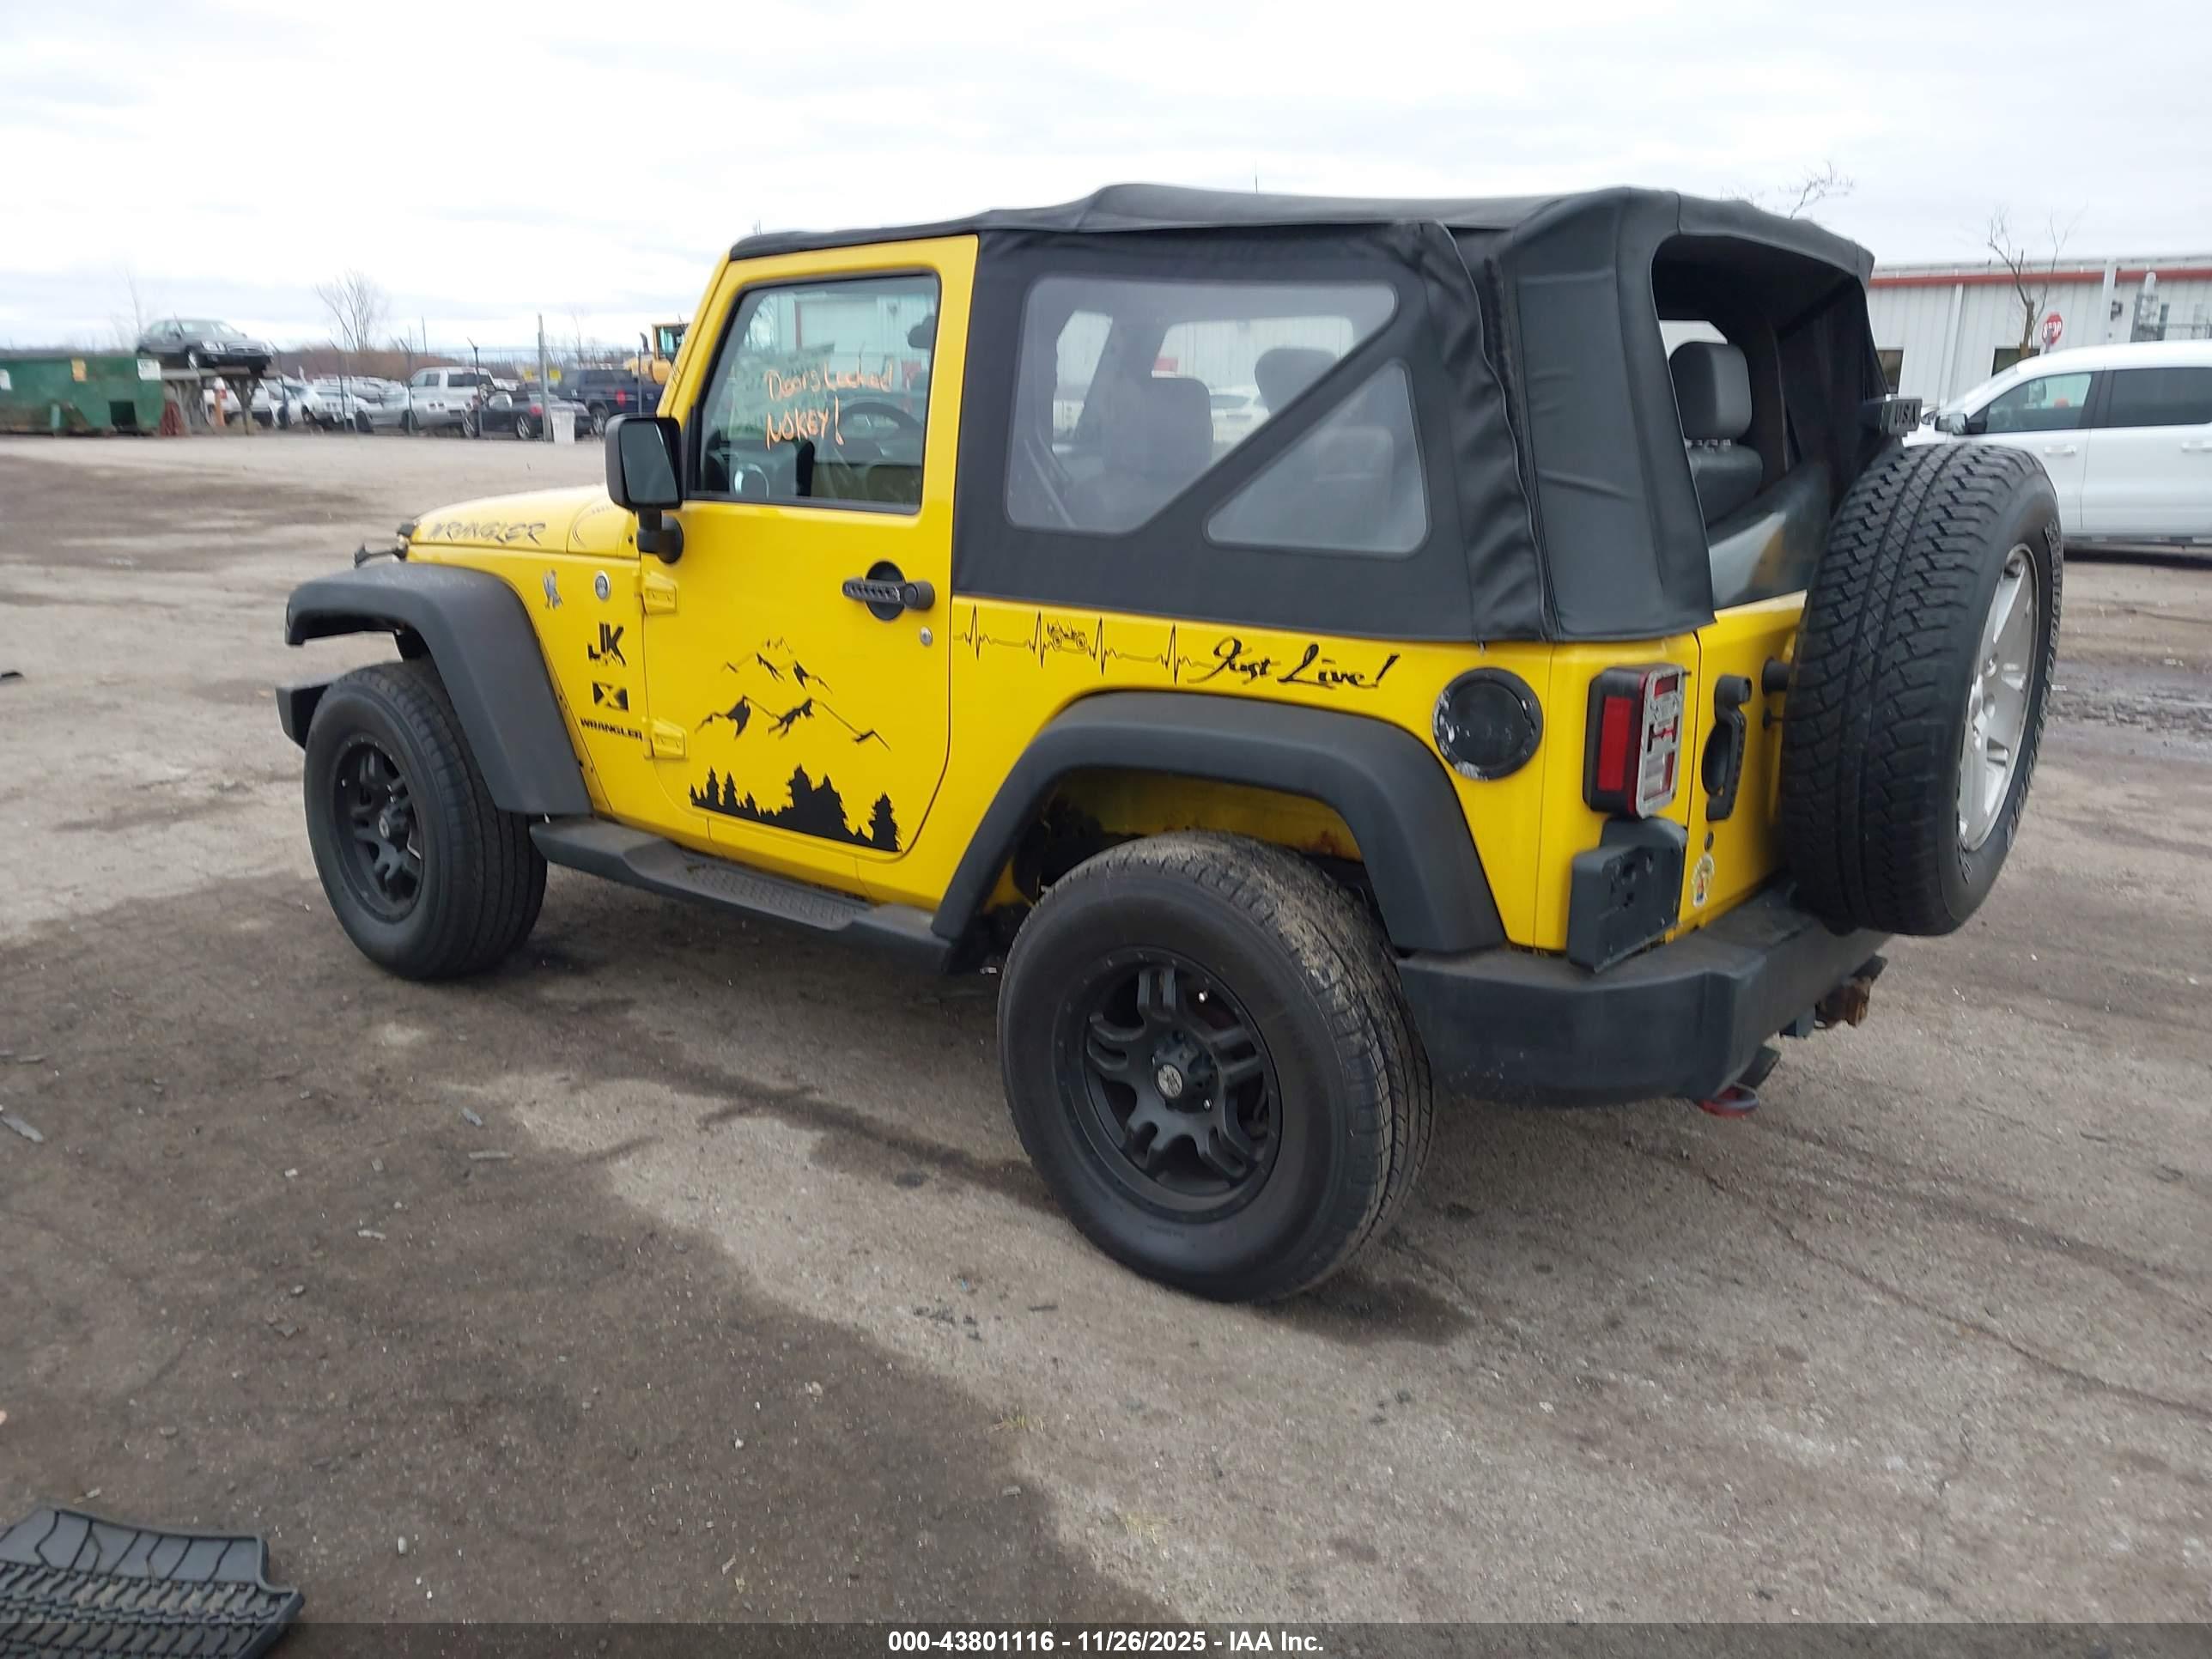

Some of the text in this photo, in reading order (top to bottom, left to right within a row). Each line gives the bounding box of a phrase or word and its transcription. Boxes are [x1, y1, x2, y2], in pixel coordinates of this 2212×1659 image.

[1894, 404, 1917, 426] USA
[586, 621, 628, 667] JK
[1188, 635, 1401, 690] Just Live!
[580, 716, 644, 741] WRANGLER
